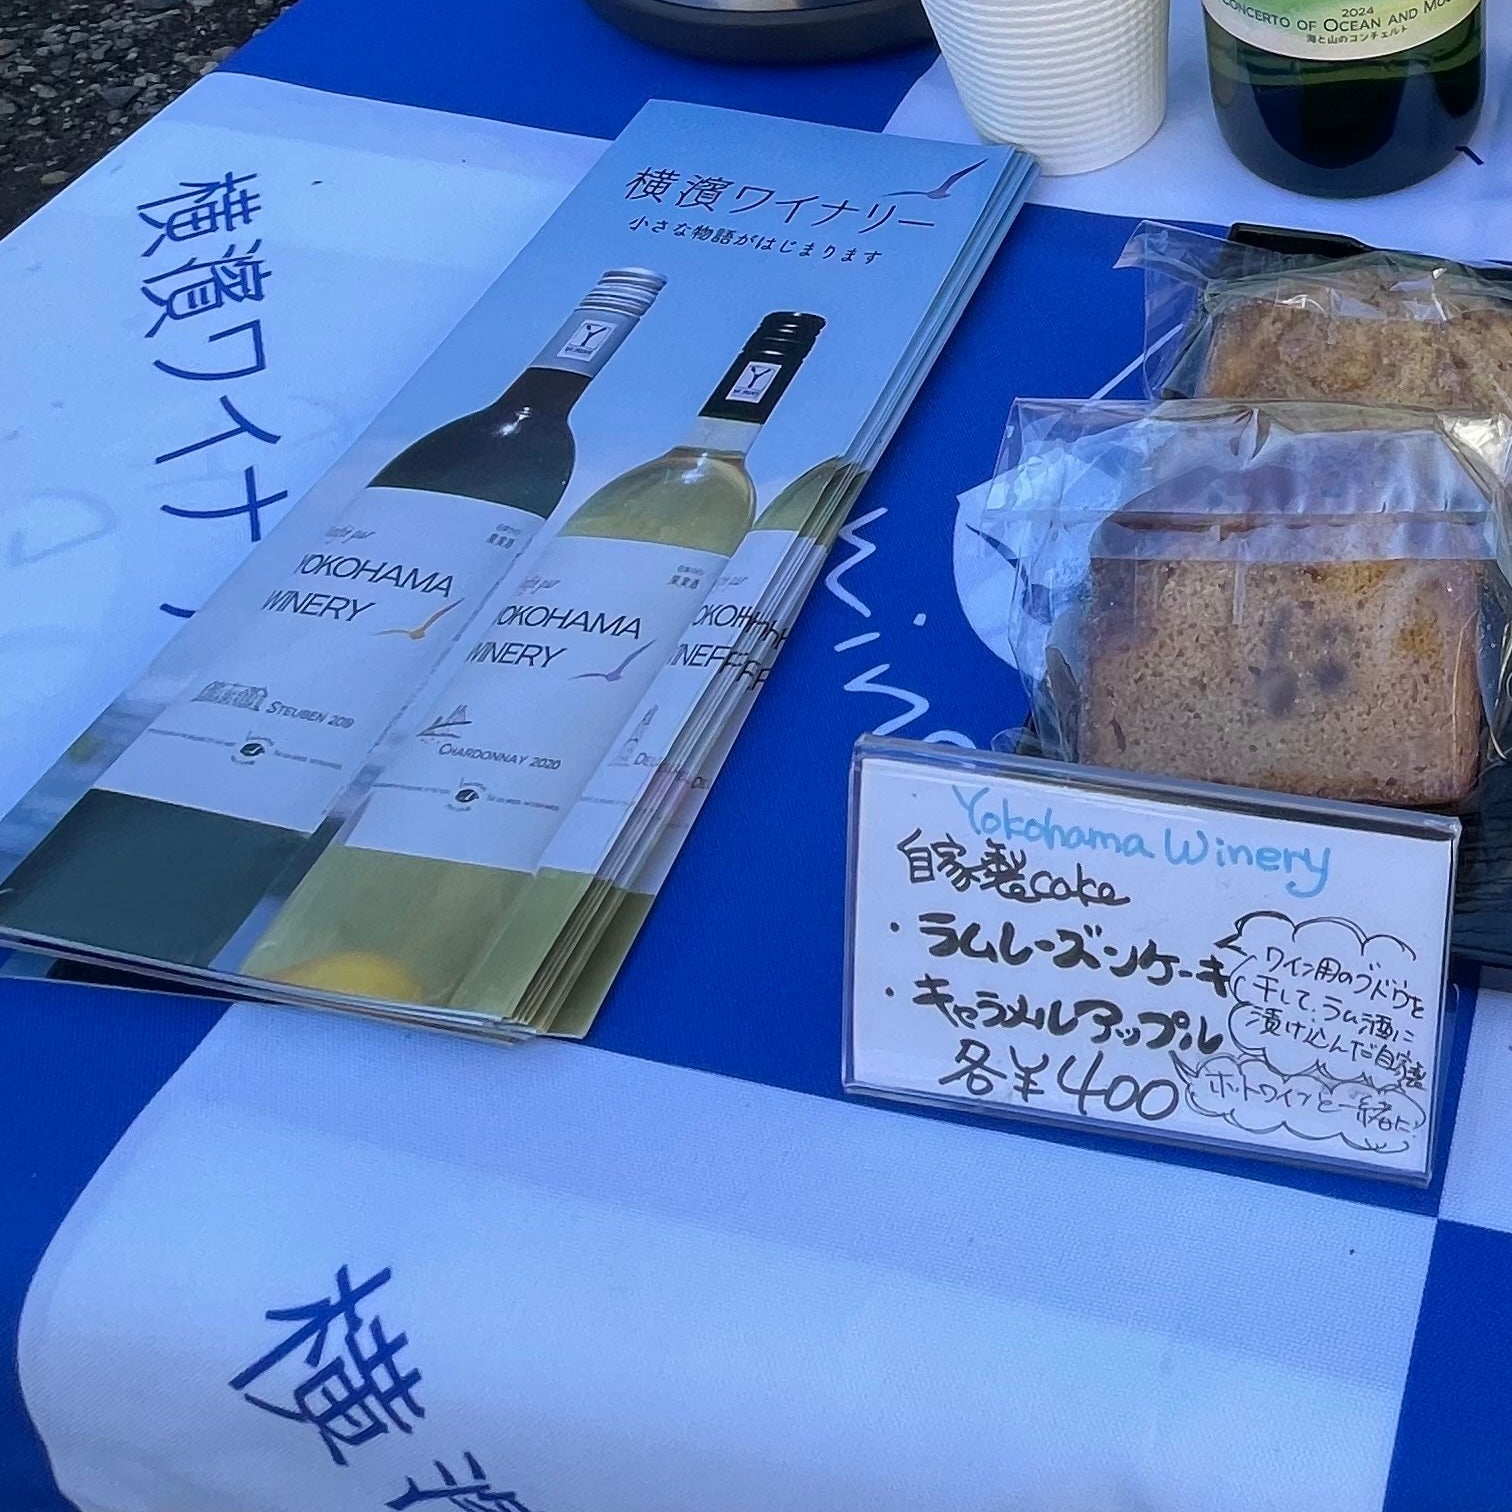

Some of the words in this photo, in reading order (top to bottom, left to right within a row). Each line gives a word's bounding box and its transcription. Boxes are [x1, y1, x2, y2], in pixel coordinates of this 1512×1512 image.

[1297, 19, 1317, 31] OF
[1323, 17, 1381, 34] OCEAN
[1388, 7, 1418, 26] AND
[1341, 6, 1374, 18] 2024
[624, 166, 935, 235] 横濱ワイナリー
[628, 215, 883, 265] 小さな物語がはじまります
[137, 171, 288, 620] 横濱ワイナ
[261, 590, 376, 622] WINERY
[438, 743, 528, 767] CHARDONNAY
[952, 784, 1155, 859] Yokohama
[1164, 825, 1333, 898] Winery
[1266, 946, 1425, 1019] ワイン用のブドウを
